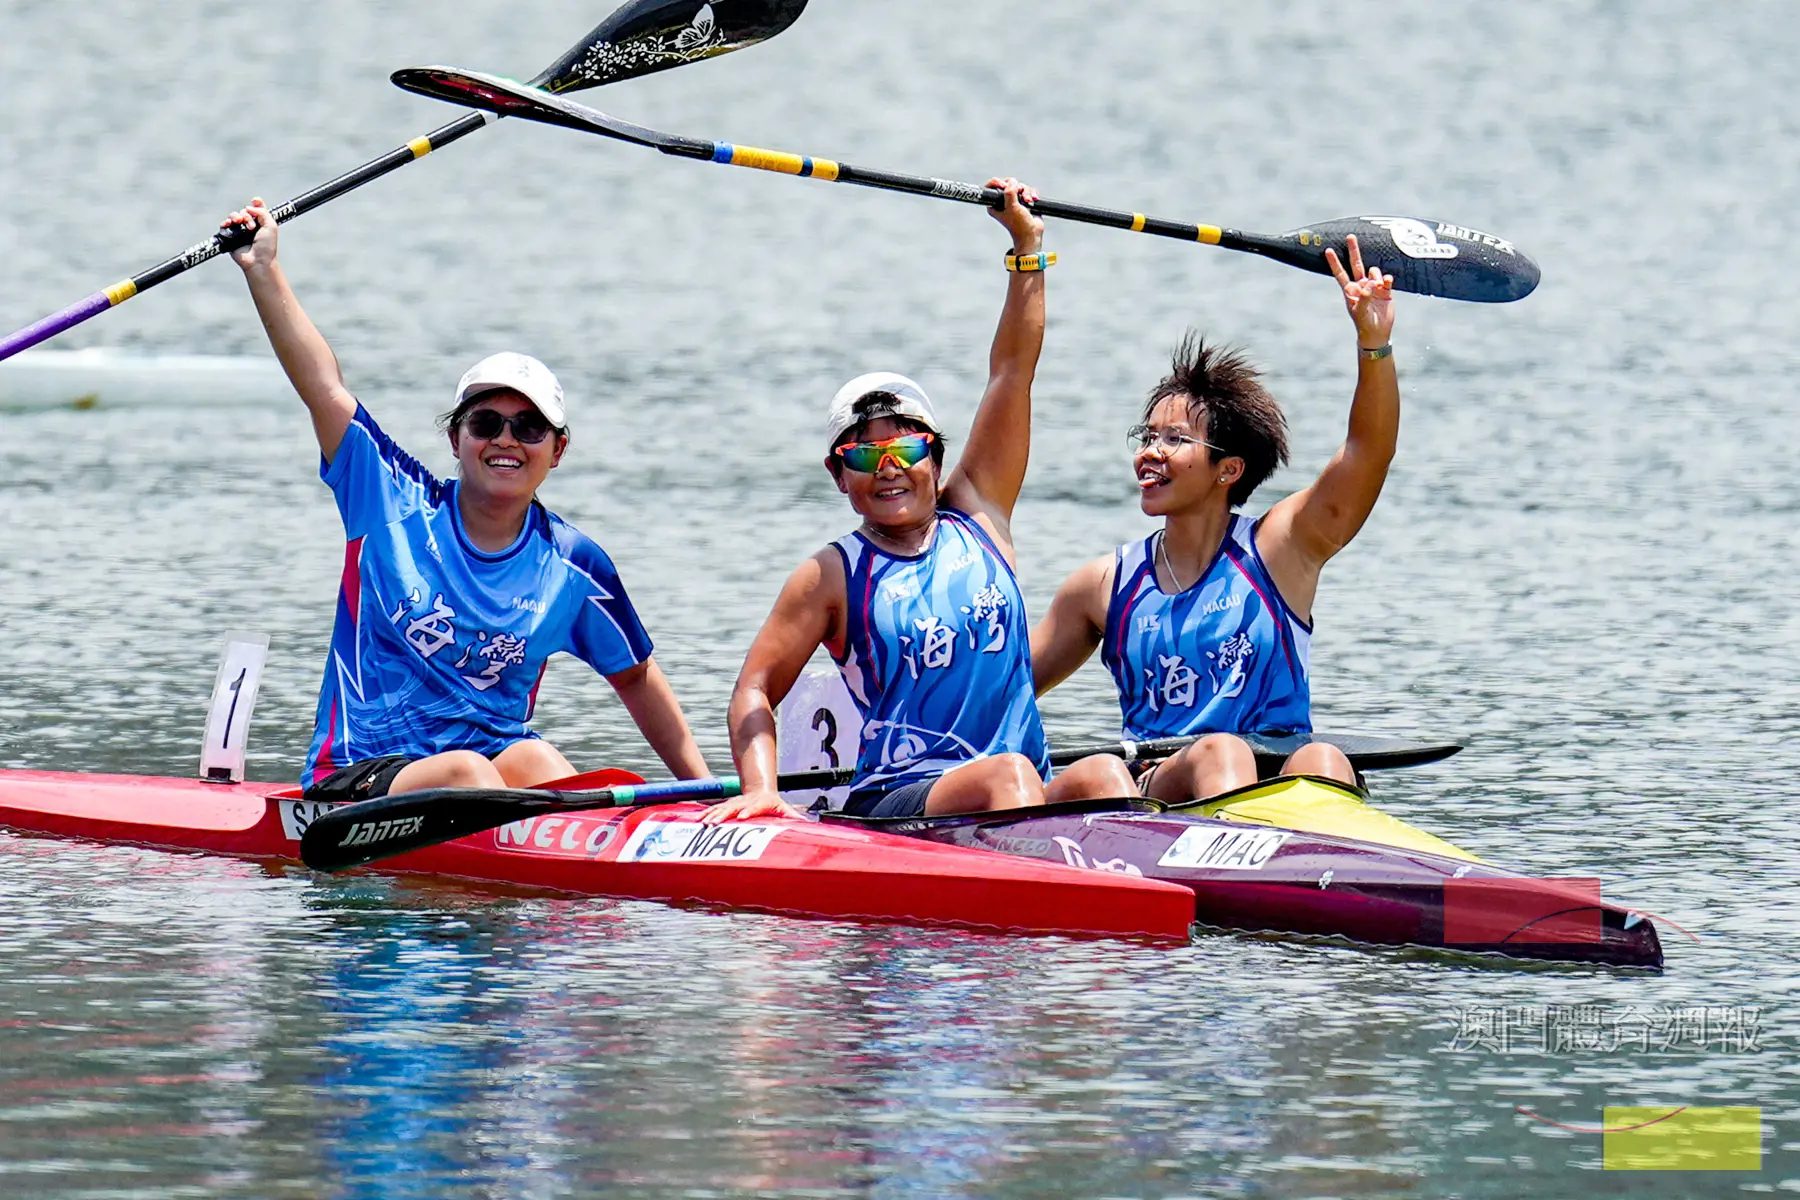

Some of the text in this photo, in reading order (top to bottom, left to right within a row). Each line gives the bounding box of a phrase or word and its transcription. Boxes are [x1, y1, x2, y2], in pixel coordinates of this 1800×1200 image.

[1202, 594, 1241, 616] MACAU
[222, 667, 247, 749] 1
[810, 707, 840, 769] 3
[499, 818, 617, 853] NELO
[681, 824, 766, 858] MAC
[1195, 832, 1282, 865] MAC
